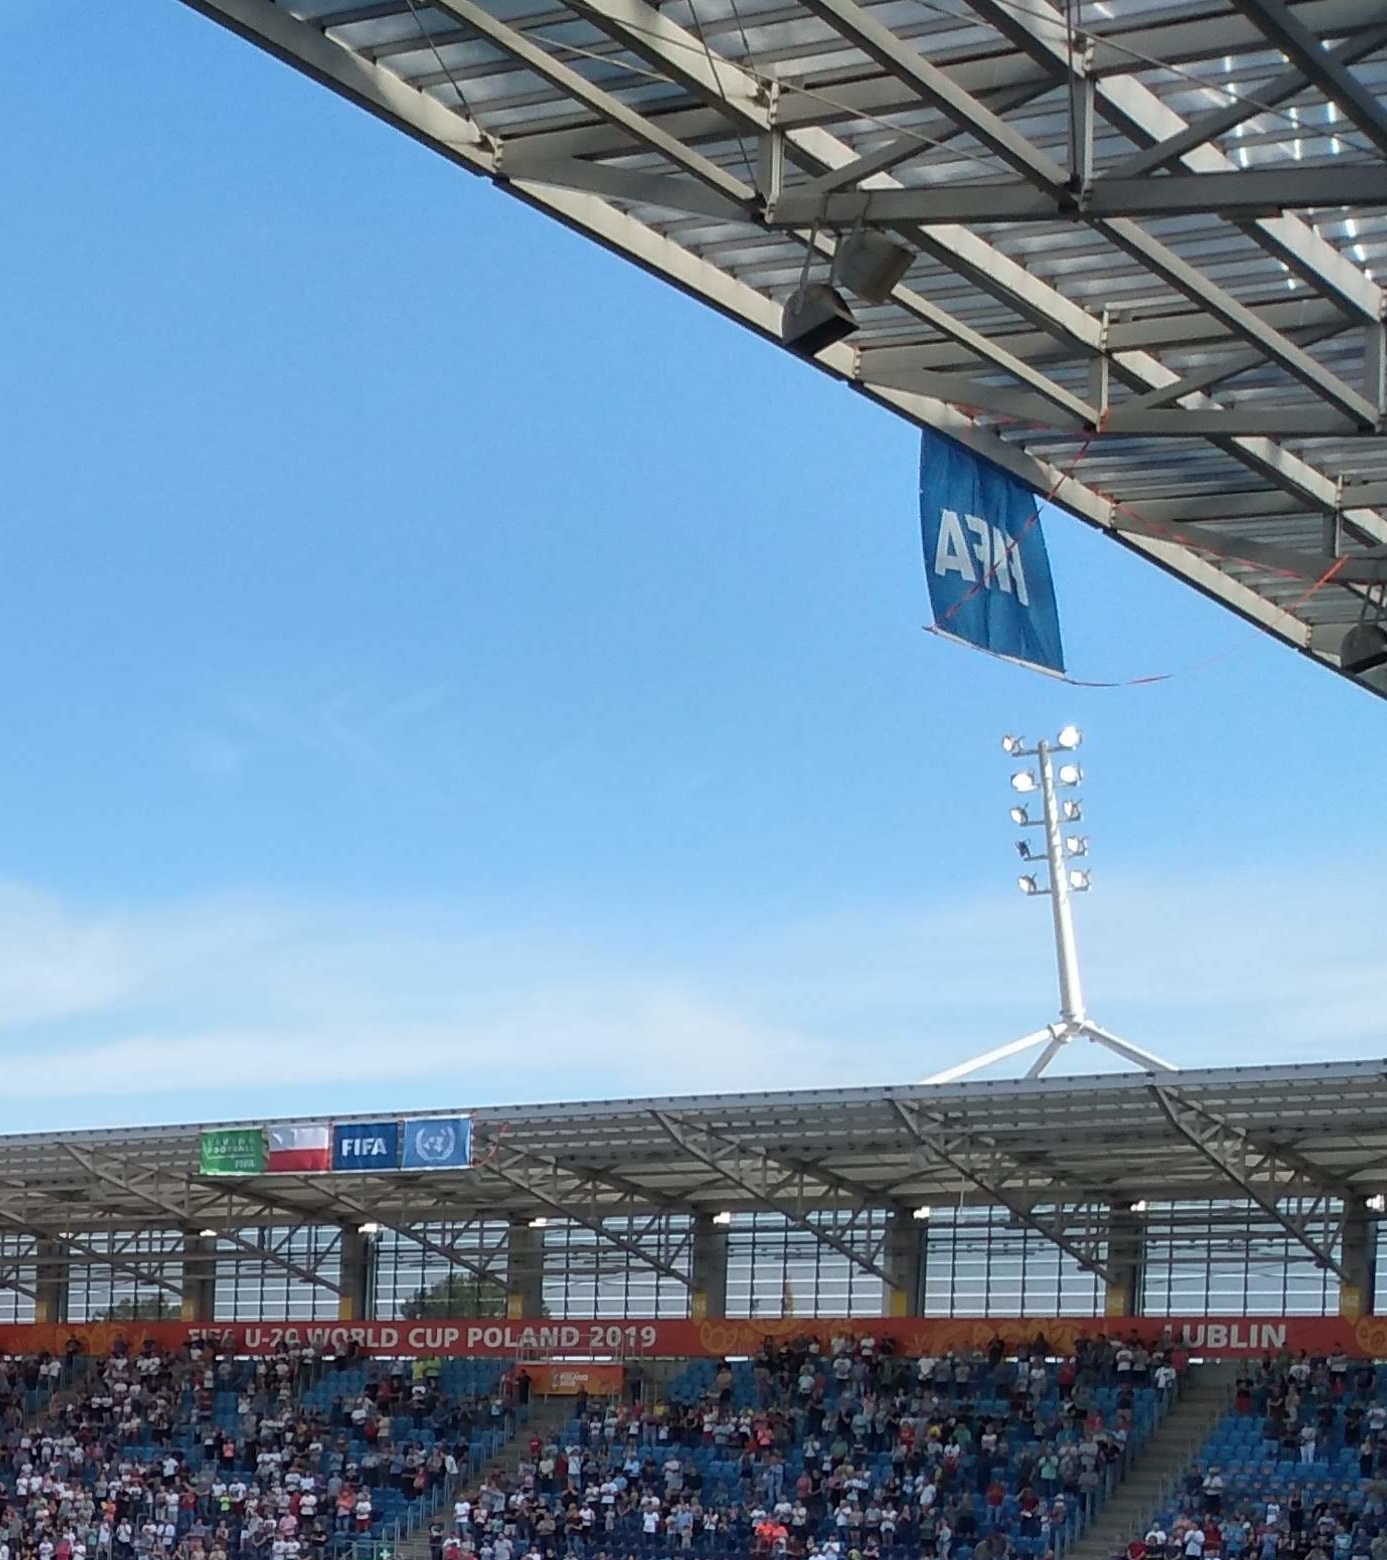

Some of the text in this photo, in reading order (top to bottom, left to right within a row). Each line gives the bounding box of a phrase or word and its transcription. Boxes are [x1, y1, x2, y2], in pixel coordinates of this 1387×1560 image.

[341, 1137, 388, 1157] FIFA
[306, 1327, 399, 1348] WORLD
[408, 1327, 459, 1348] CUP
[467, 1327, 580, 1348] POLAND
[590, 1326, 657, 1347] 2019
